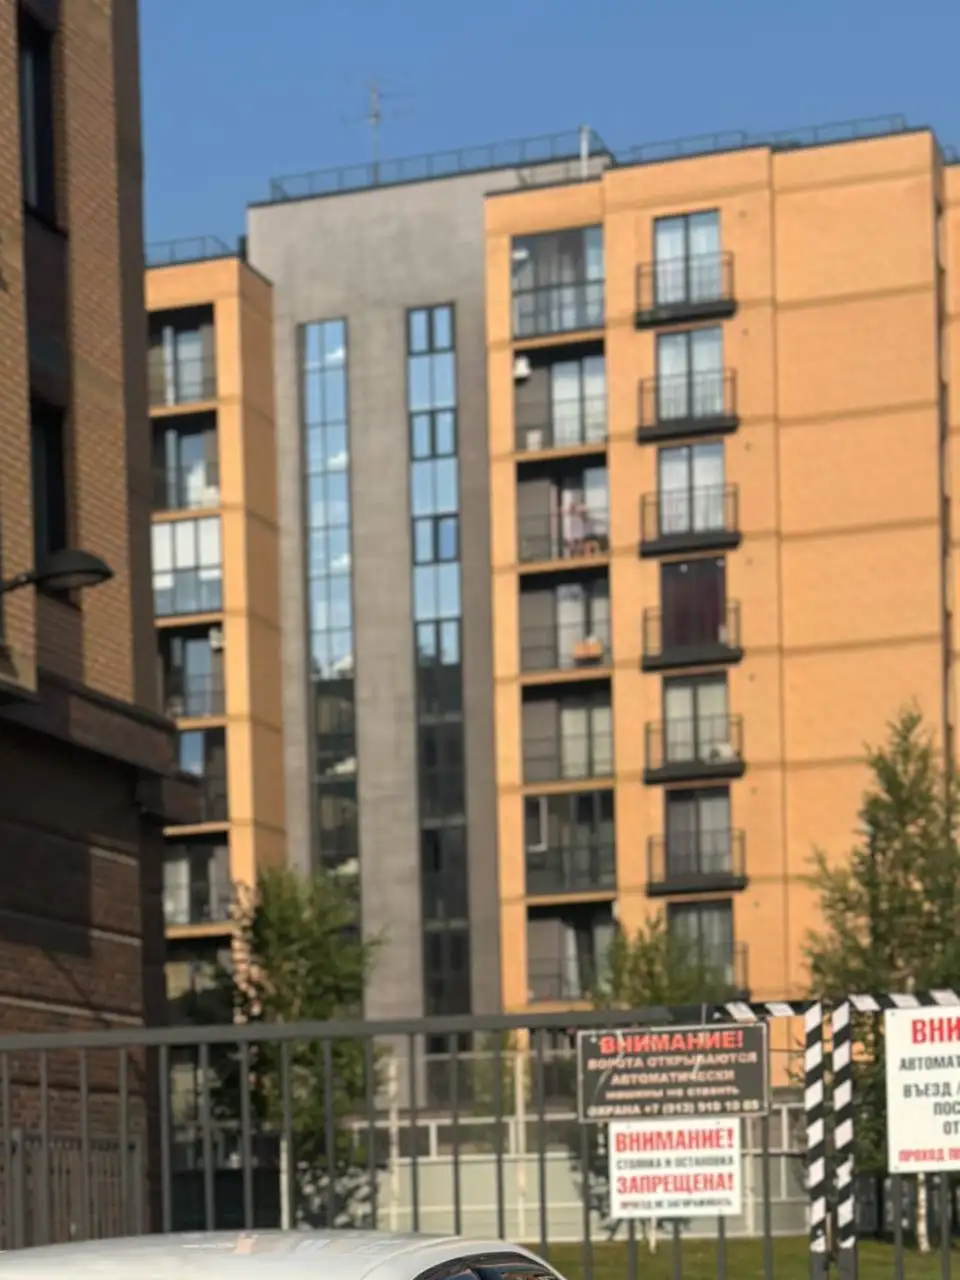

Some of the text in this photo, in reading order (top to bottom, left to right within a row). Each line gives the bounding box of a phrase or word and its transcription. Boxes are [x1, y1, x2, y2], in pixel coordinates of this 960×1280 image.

[599, 1030, 744, 1055] ВНИМАНИЕ!
[587, 1052, 757, 1070] ВОРОТА ОТКРЫВАЮТСЯ
[611, 1070, 735, 1086] АВТОМАТИЧЕСКИ
[903, 1082, 952, 1098] ВЪЕЗД
[615, 1127, 734, 1152] ВНИМАНИЕ!
[616, 1172, 734, 1195] ЗАПРЕЩЕНА!
